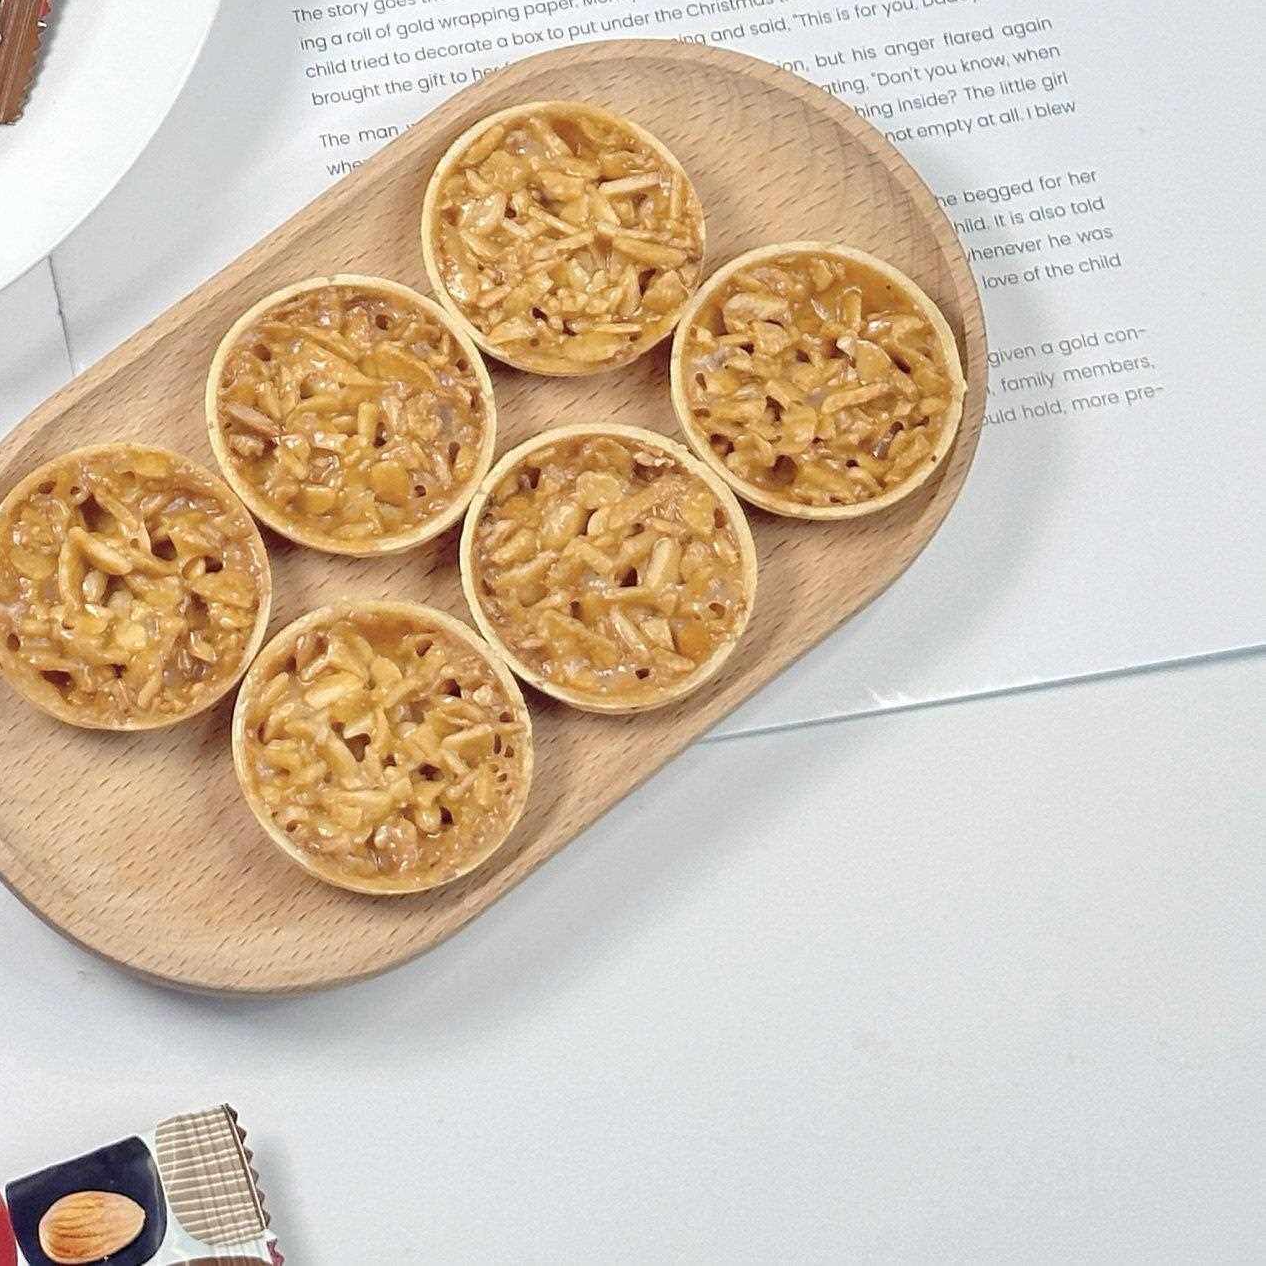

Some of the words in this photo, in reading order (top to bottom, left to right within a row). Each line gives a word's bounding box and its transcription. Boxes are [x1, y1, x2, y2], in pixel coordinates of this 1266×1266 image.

[292, 7, 323, 23] The
[328, 1, 369, 19] story
[300, 36, 327, 52] ing
[331, 34, 343, 45] a
[346, 27, 372, 44] roll
[375, 24, 391, 39] of
[396, 18, 435, 39] gold
[438, 6, 520, 29] wrapping
[711, 24, 745, 42] and
[836, 6, 850, 22] is
[854, 2, 879, 18] for
[306, 59, 347, 79] child
[351, 53, 389, 71] tried
[394, 50, 411, 65] to
[415, 37, 492, 62] decorate
[497, 36, 509, 48] a
[512, 29, 544, 47] box
[547, 24, 564, 41] to
[568, 20, 598, 41] put
[601, 12, 649, 33] under
[654, 7, 683, 24] the
[815, 53, 845, 68] but
[851, 45, 877, 62] his
[884, 37, 936, 57] anger
[942, 25, 995, 47] flared
[1001, 17, 1053, 39] again
[924, 62, 957, 84] you
[1013, 45, 1062, 65] when
[312, 84, 382, 107] brought
[385, 80, 414, 95] the
[417, 72, 447, 94] gift
[450, 71, 468, 84] to
[897, 89, 957, 114] inside?
[964, 83, 995, 101] The
[999, 77, 1036, 95] little
[1041, 70, 1069, 92] girl
[319, 132, 350, 148] The
[358, 125, 399, 142] man
[917, 117, 973, 140] empty
[977, 113, 995, 128] at
[1025, 107, 1032, 120] I
[1034, 100, 1076, 118] blew
[963, 177, 1034, 203] begged
[1038, 172, 1063, 191] for
[1067, 168, 1097, 185] her
[953, 216, 990, 235] hild.
[993, 212, 1006, 229] It
[1009, 209, 1025, 225] is
[1028, 202, 1066, 223] also
[1070, 195, 1106, 215] told
[1048, 230, 1072, 249] he
[1076, 224, 1114, 243] was
[982, 270, 1019, 290] love
[1023, 266, 1041, 283] of
[1045, 260, 1075, 279] the
[1078, 252, 1122, 273] child
[1041, 342, 1054, 355] a
[1059, 333, 1100, 356] gold
[1104, 325, 1147, 344] con-
[1000, 369, 1055, 392] family
[1062, 353, 1156, 384] members,
[982, 407, 1017, 427] ould
[1072, 391, 1120, 412] more
[1124, 383, 1165, 406] pre-
